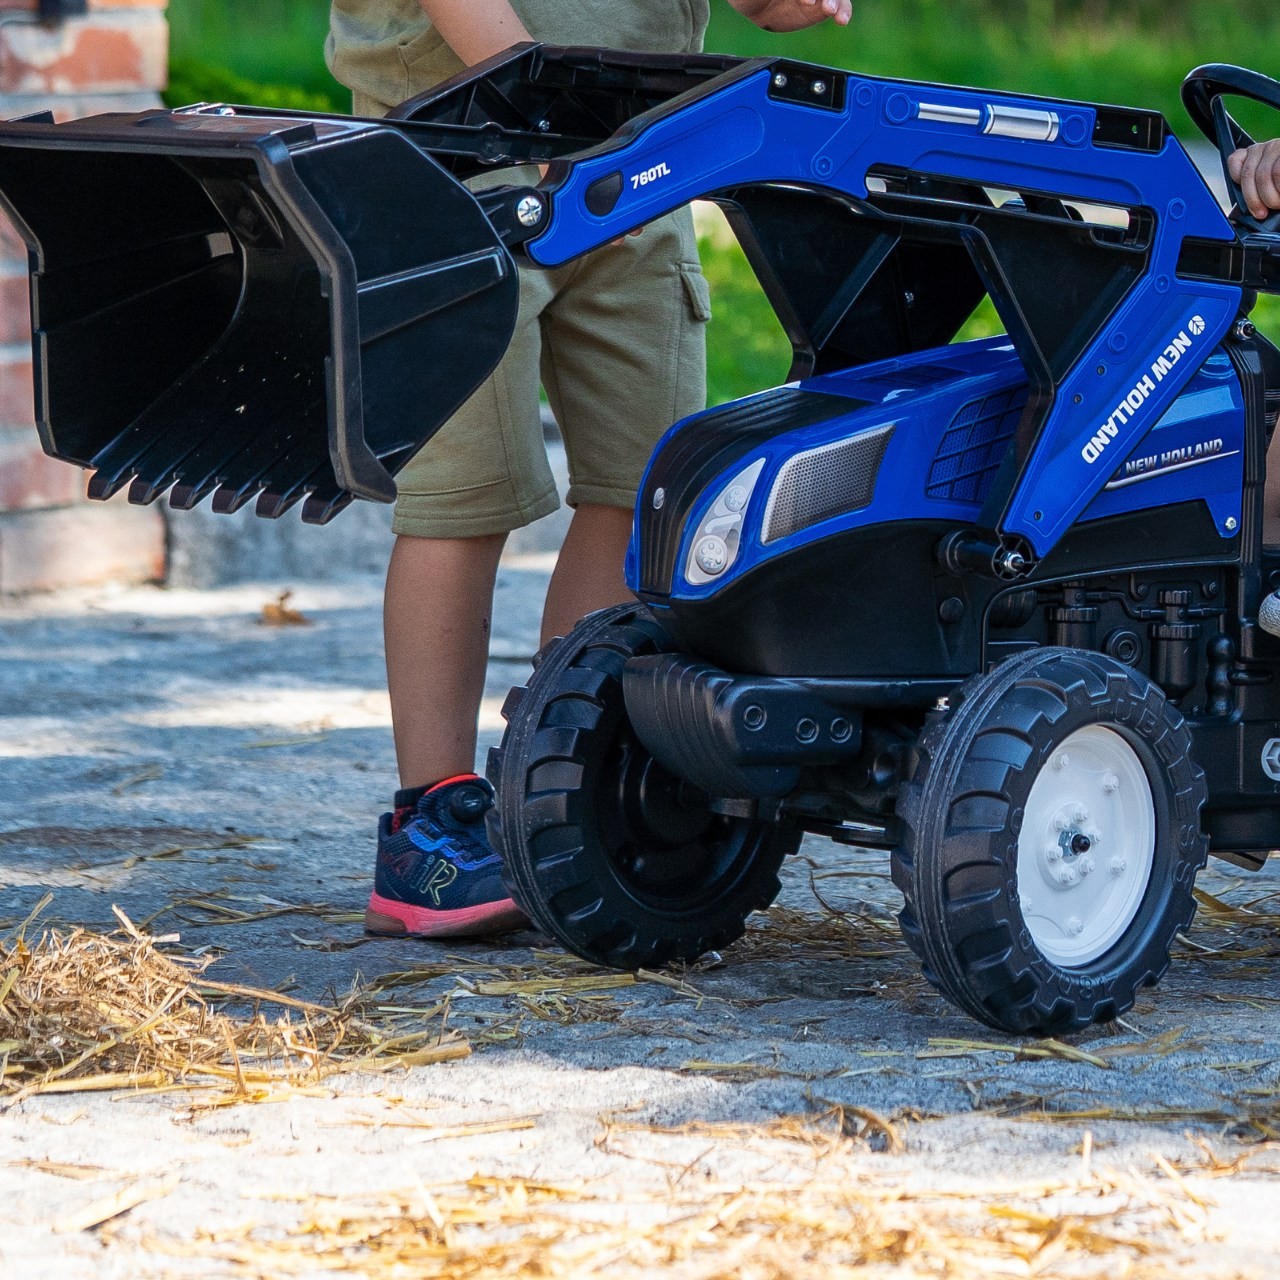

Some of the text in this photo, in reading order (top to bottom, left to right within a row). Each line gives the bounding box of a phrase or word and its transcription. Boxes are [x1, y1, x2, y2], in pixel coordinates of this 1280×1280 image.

[630, 162, 671, 190] 760TL
[1081, 330, 1192, 464] NEW HOLLAND
[1125, 438, 1223, 477] NEW HOLLAND
